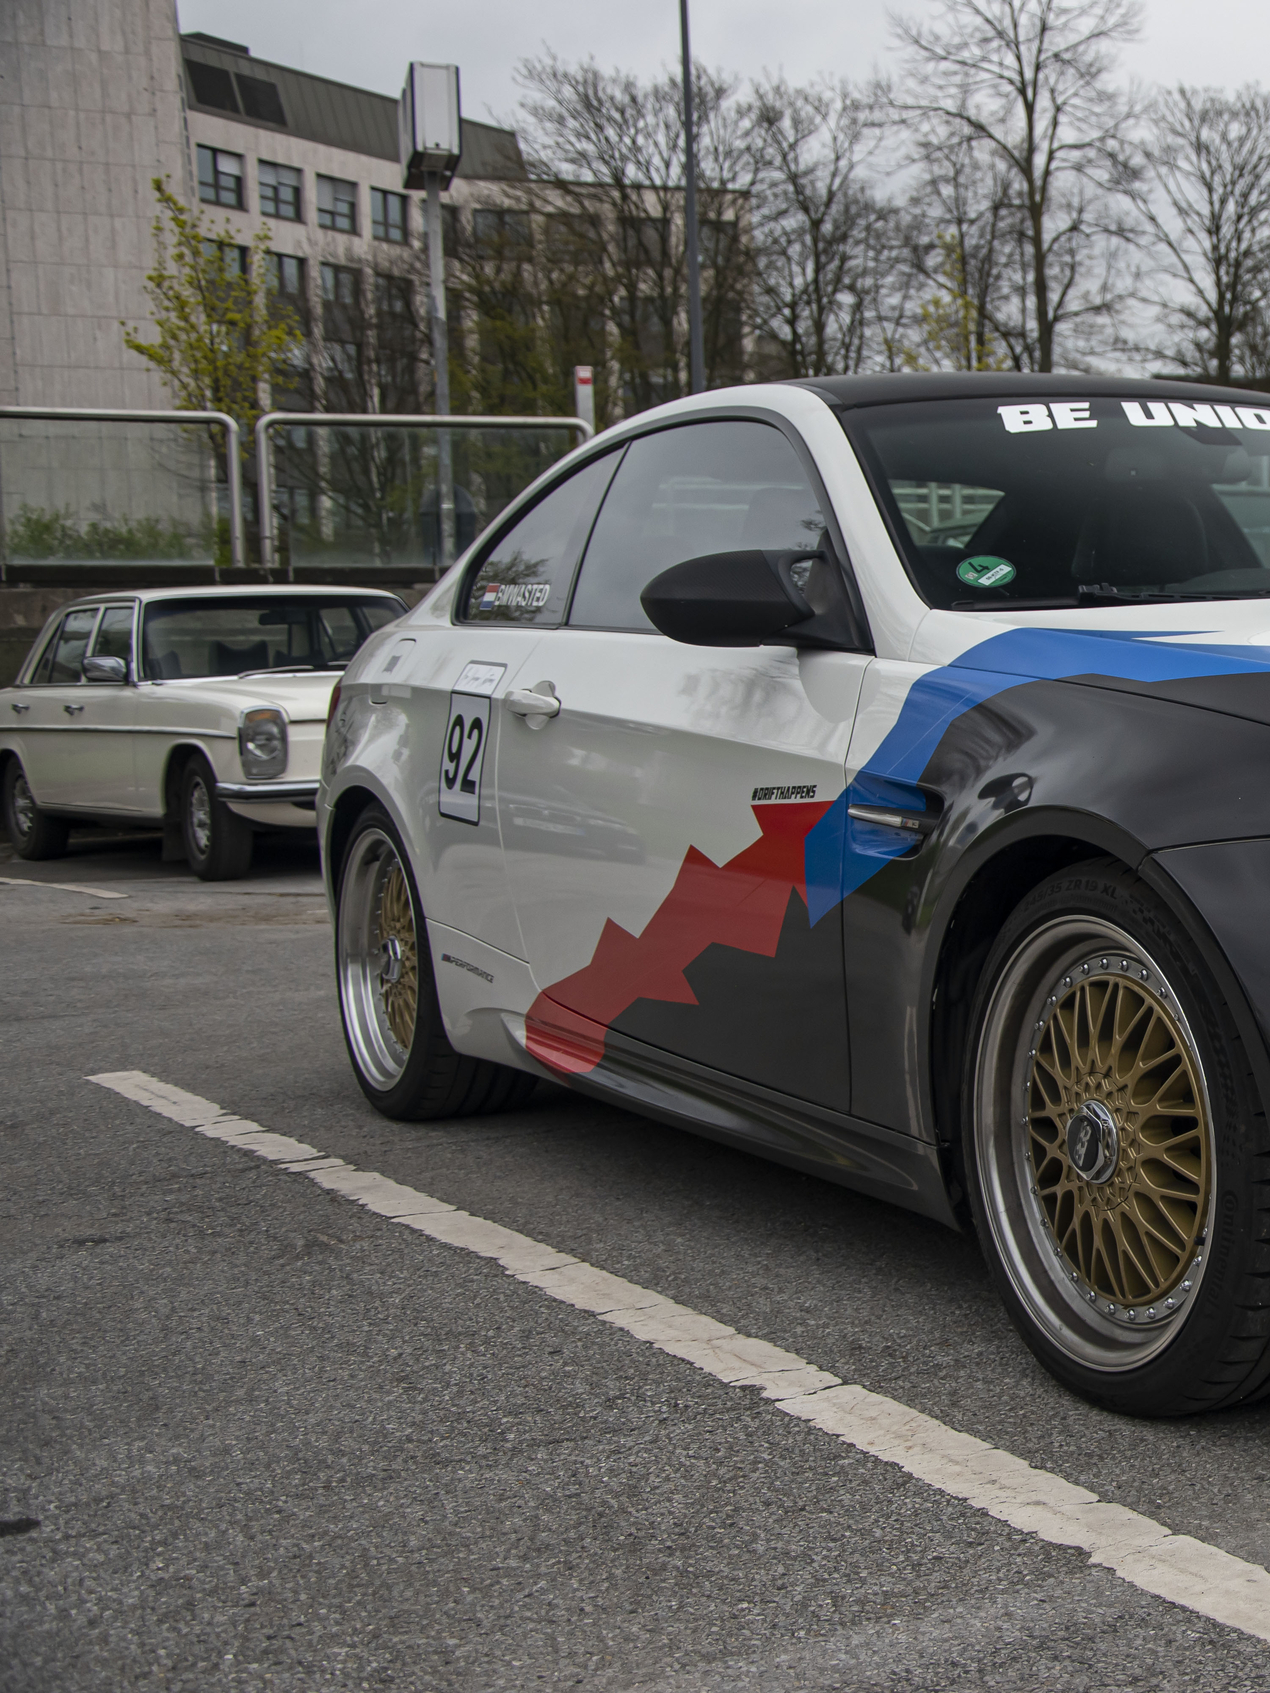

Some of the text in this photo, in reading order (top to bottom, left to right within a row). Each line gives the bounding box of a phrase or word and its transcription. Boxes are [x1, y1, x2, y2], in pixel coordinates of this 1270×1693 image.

[997, 402, 1098, 434] BE
[494, 584, 551, 607] BMWASTED
[444, 713, 483, 795] 92
[751, 784, 818, 801] #DRIFTHAPPENS
